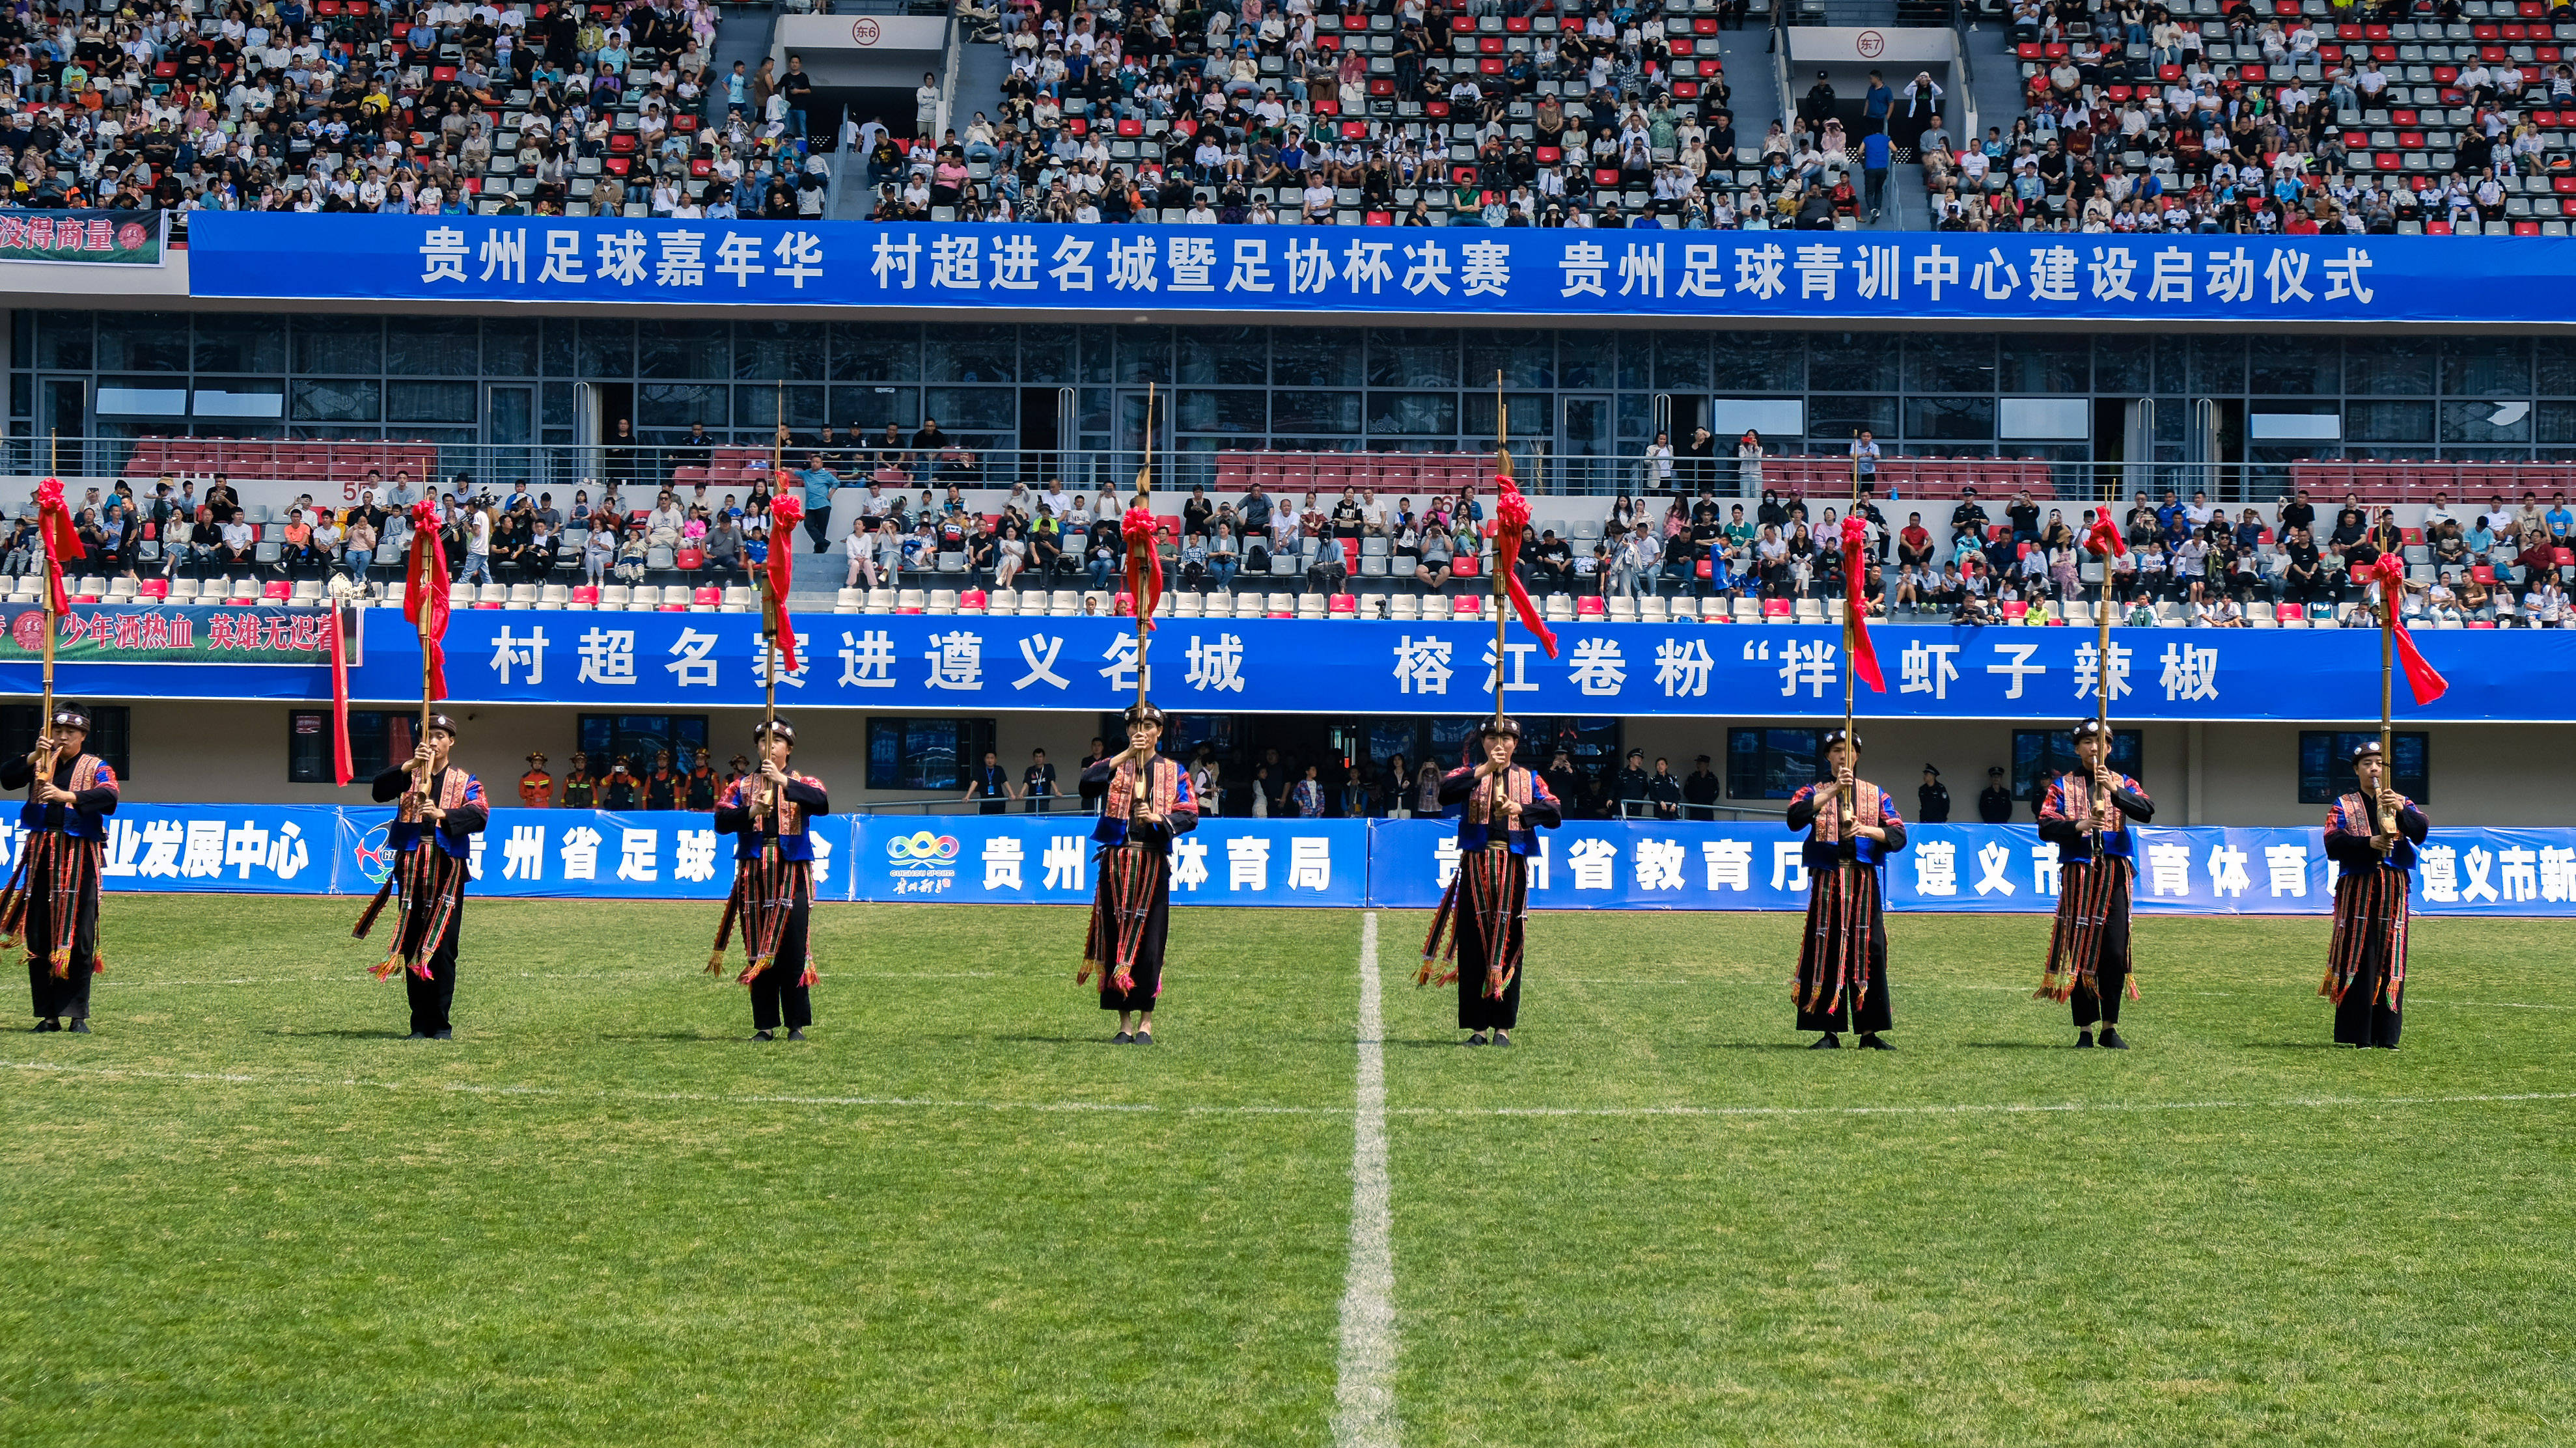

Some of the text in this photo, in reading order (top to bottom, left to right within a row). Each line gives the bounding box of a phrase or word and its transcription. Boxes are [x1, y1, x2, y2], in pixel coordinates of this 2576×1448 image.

[857, 26, 876, 38] 东6
[1861, 38, 1880, 50] 东7
[0, 215, 115, 252] 没得商量
[419, 226, 2374, 304] 贵州足球嘉年华 村超进名城暨足协杯决赛 贵州足球青训中心建设启动仪式
[60, 612, 195, 650] 少年洒热血
[208, 612, 333, 651] 英雄无迟暮
[490, 625, 1245, 693] 村超名赛进遵义名城
[0, 817, 309, 879] 业发展中心
[465, 825, 833, 883] 州省足球
[982, 835, 1331, 892] 贵州体育局
[1915, 840, 2340, 897] 遵义市育体育
